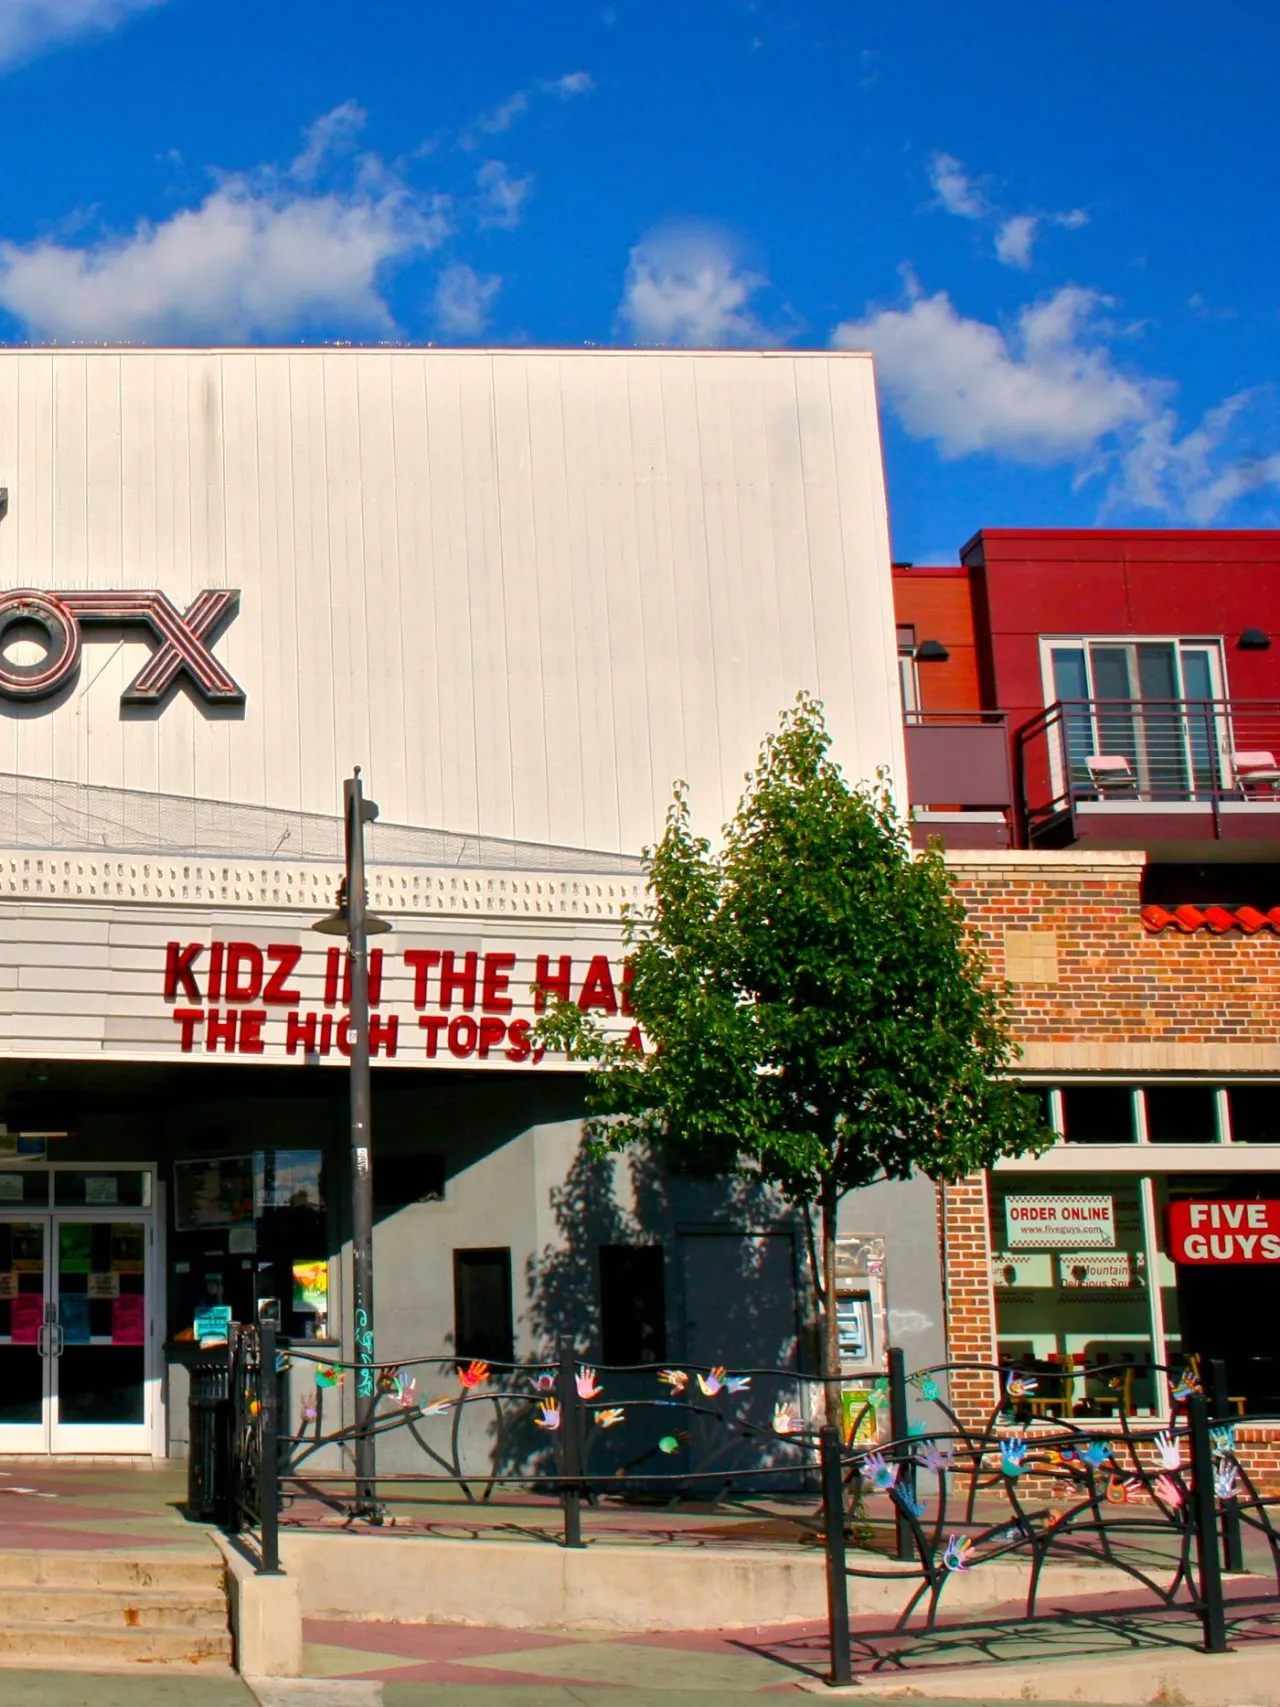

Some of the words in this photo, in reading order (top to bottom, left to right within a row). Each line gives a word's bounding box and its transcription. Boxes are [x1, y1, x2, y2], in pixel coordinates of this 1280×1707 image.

[163, 941, 302, 1006] KIDZ
[323, 947, 383, 1009] IN
[403, 949, 516, 1014] THE
[173, 1008, 267, 1054] THE
[418, 1015, 546, 1065] TOPS,
[1010, 1207, 1057, 1221] ORDER
[1061, 1207, 1110, 1221] ONLINE
[1189, 1203, 1269, 1229] FIVE
[1020, 1224, 1102, 1235] www.fiveguys.com
[1183, 1233, 1280, 1260] GUYS
